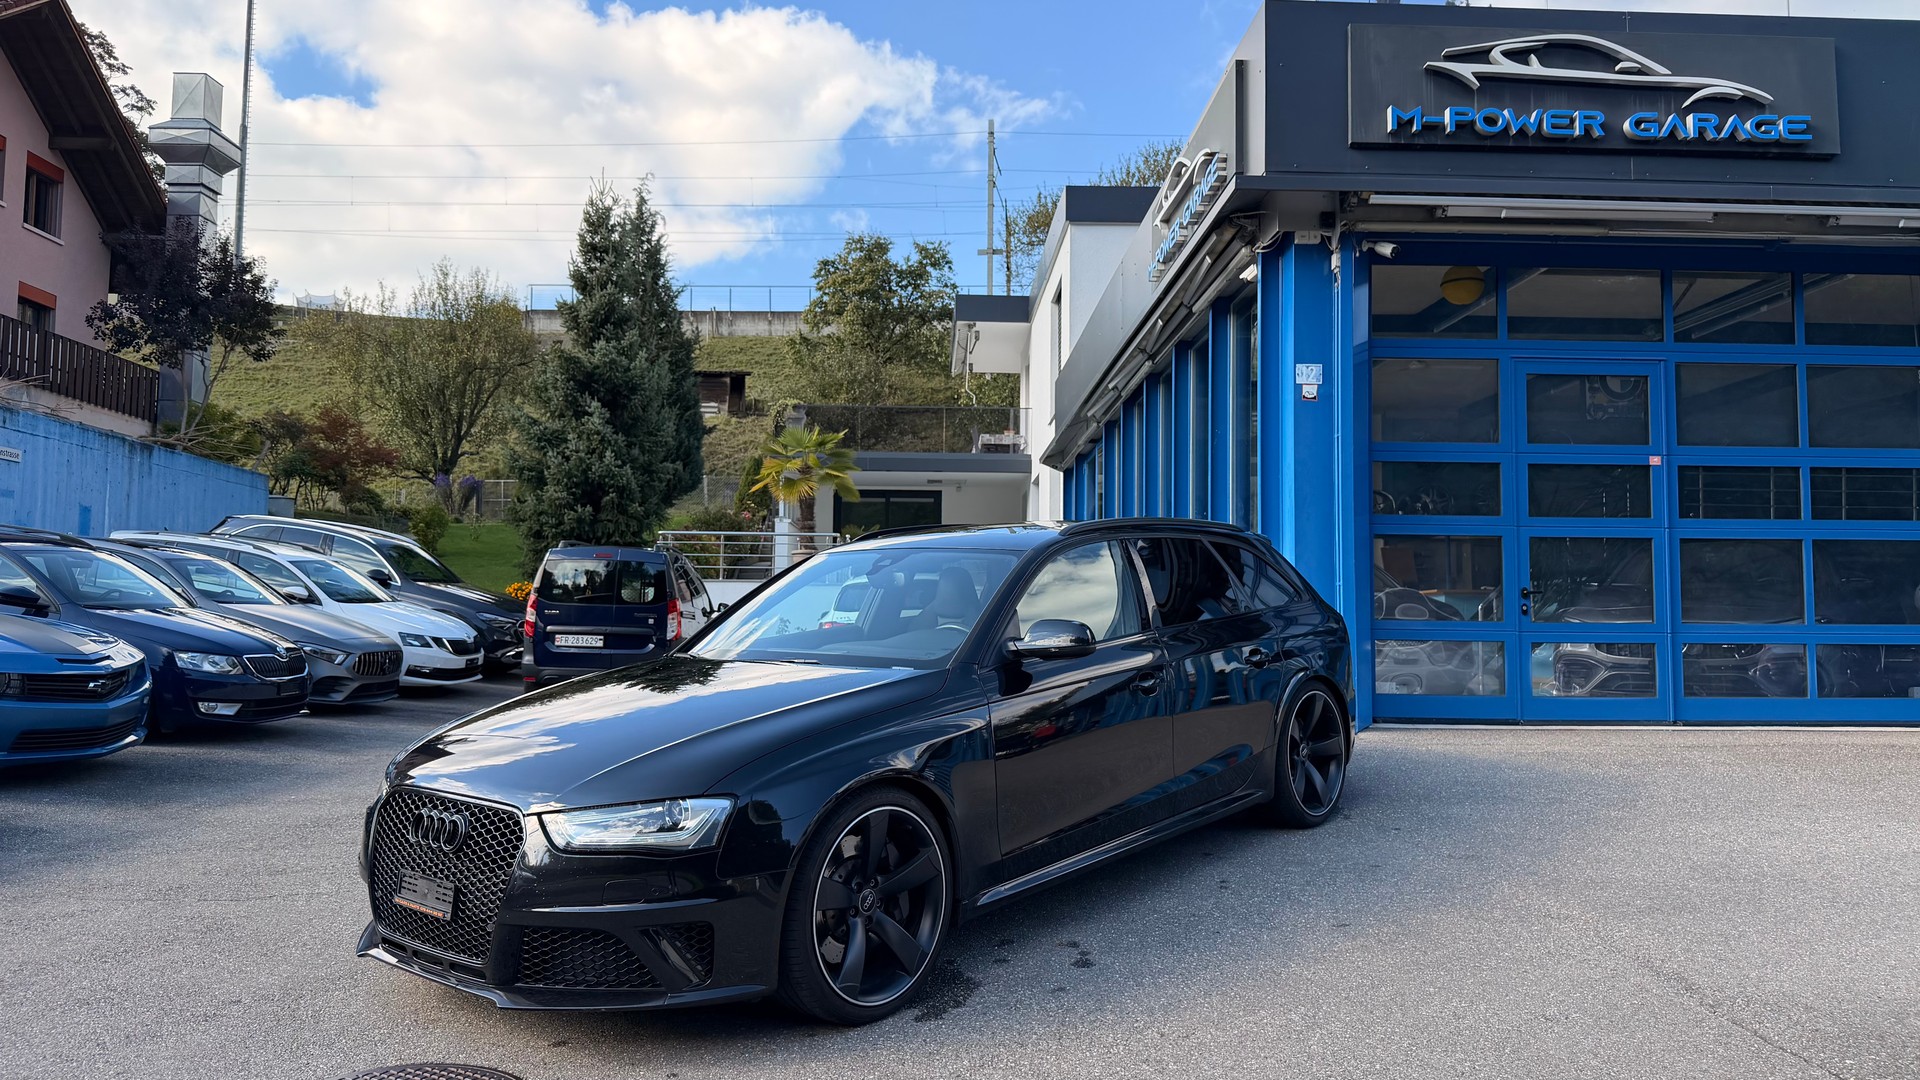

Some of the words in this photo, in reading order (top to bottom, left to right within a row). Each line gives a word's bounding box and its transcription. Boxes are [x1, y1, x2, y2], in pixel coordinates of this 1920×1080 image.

[1388, 105, 1606, 138] M-POWER
[1626, 111, 1813, 142] GARAGE
[1182, 153, 1220, 226] GARAGE
